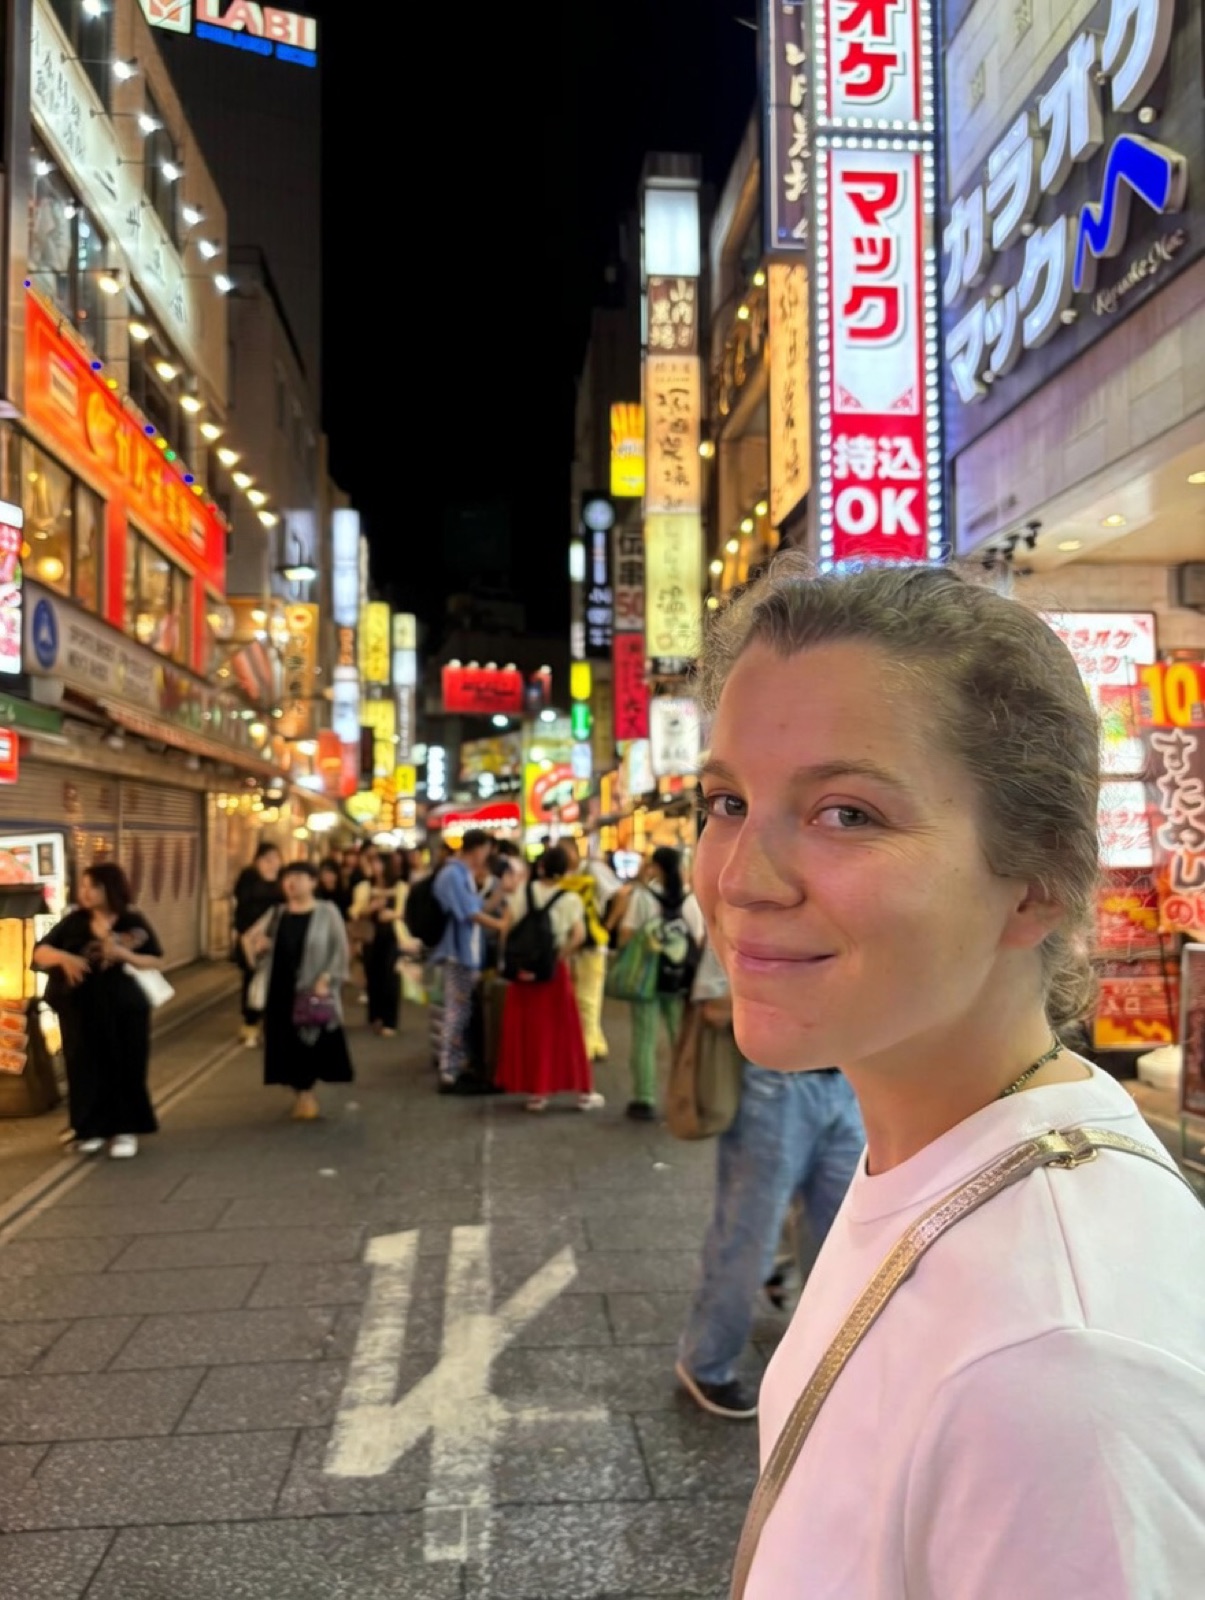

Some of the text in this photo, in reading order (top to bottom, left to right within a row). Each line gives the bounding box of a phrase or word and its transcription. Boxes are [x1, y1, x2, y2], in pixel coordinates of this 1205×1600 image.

[196, 0, 317, 50] LABI
[841, 170, 900, 341] マック
[946, 214, 1068, 403] マック
[834, 433, 922, 480] 持込
[835, 487, 922, 535] OK
[1141, 663, 1199, 726] 10
